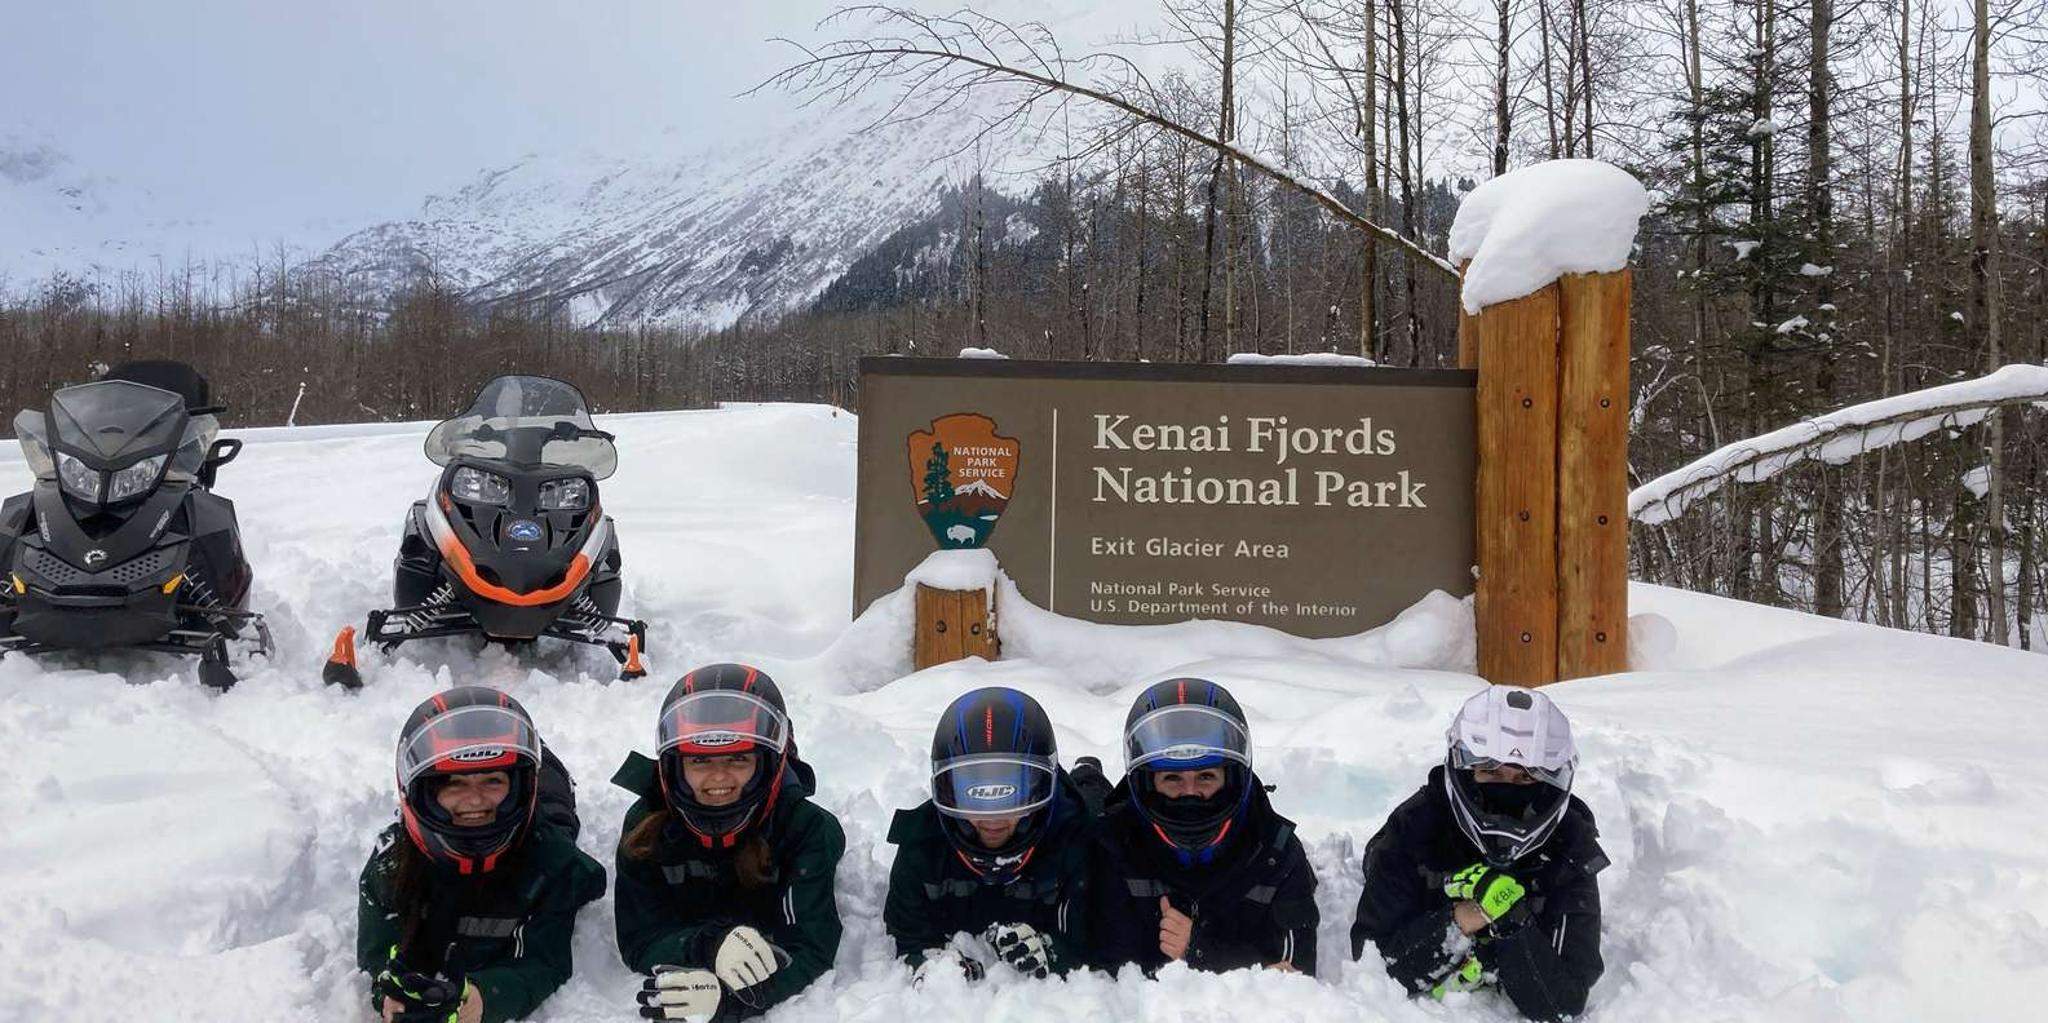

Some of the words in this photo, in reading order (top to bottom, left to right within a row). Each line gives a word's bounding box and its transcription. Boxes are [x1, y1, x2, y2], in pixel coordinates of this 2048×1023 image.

[1092, 413, 1232, 452] Kenai
[1245, 415, 1397, 465] Fjords
[953, 446, 1012, 457] NATIONAL
[967, 457, 998, 467] PARK
[959, 468, 1007, 478] SERVICE
[1091, 466, 1300, 506] National
[1313, 469, 1428, 508] Park
[1091, 536, 1136, 556] Exit
[1145, 536, 1225, 557] Glacier
[1234, 539, 1290, 559] Area
[1090, 581, 1161, 595] National
[1168, 582, 1205, 596] Park
[1211, 583, 1271, 598] Service
[1090, 599, 1121, 613] U.S.
[1127, 599, 1228, 616] Department
[1236, 601, 1256, 615] of
[1261, 601, 1290, 616] the
[1296, 602, 1358, 617] Interior
[971, 785, 1012, 797] HJC
